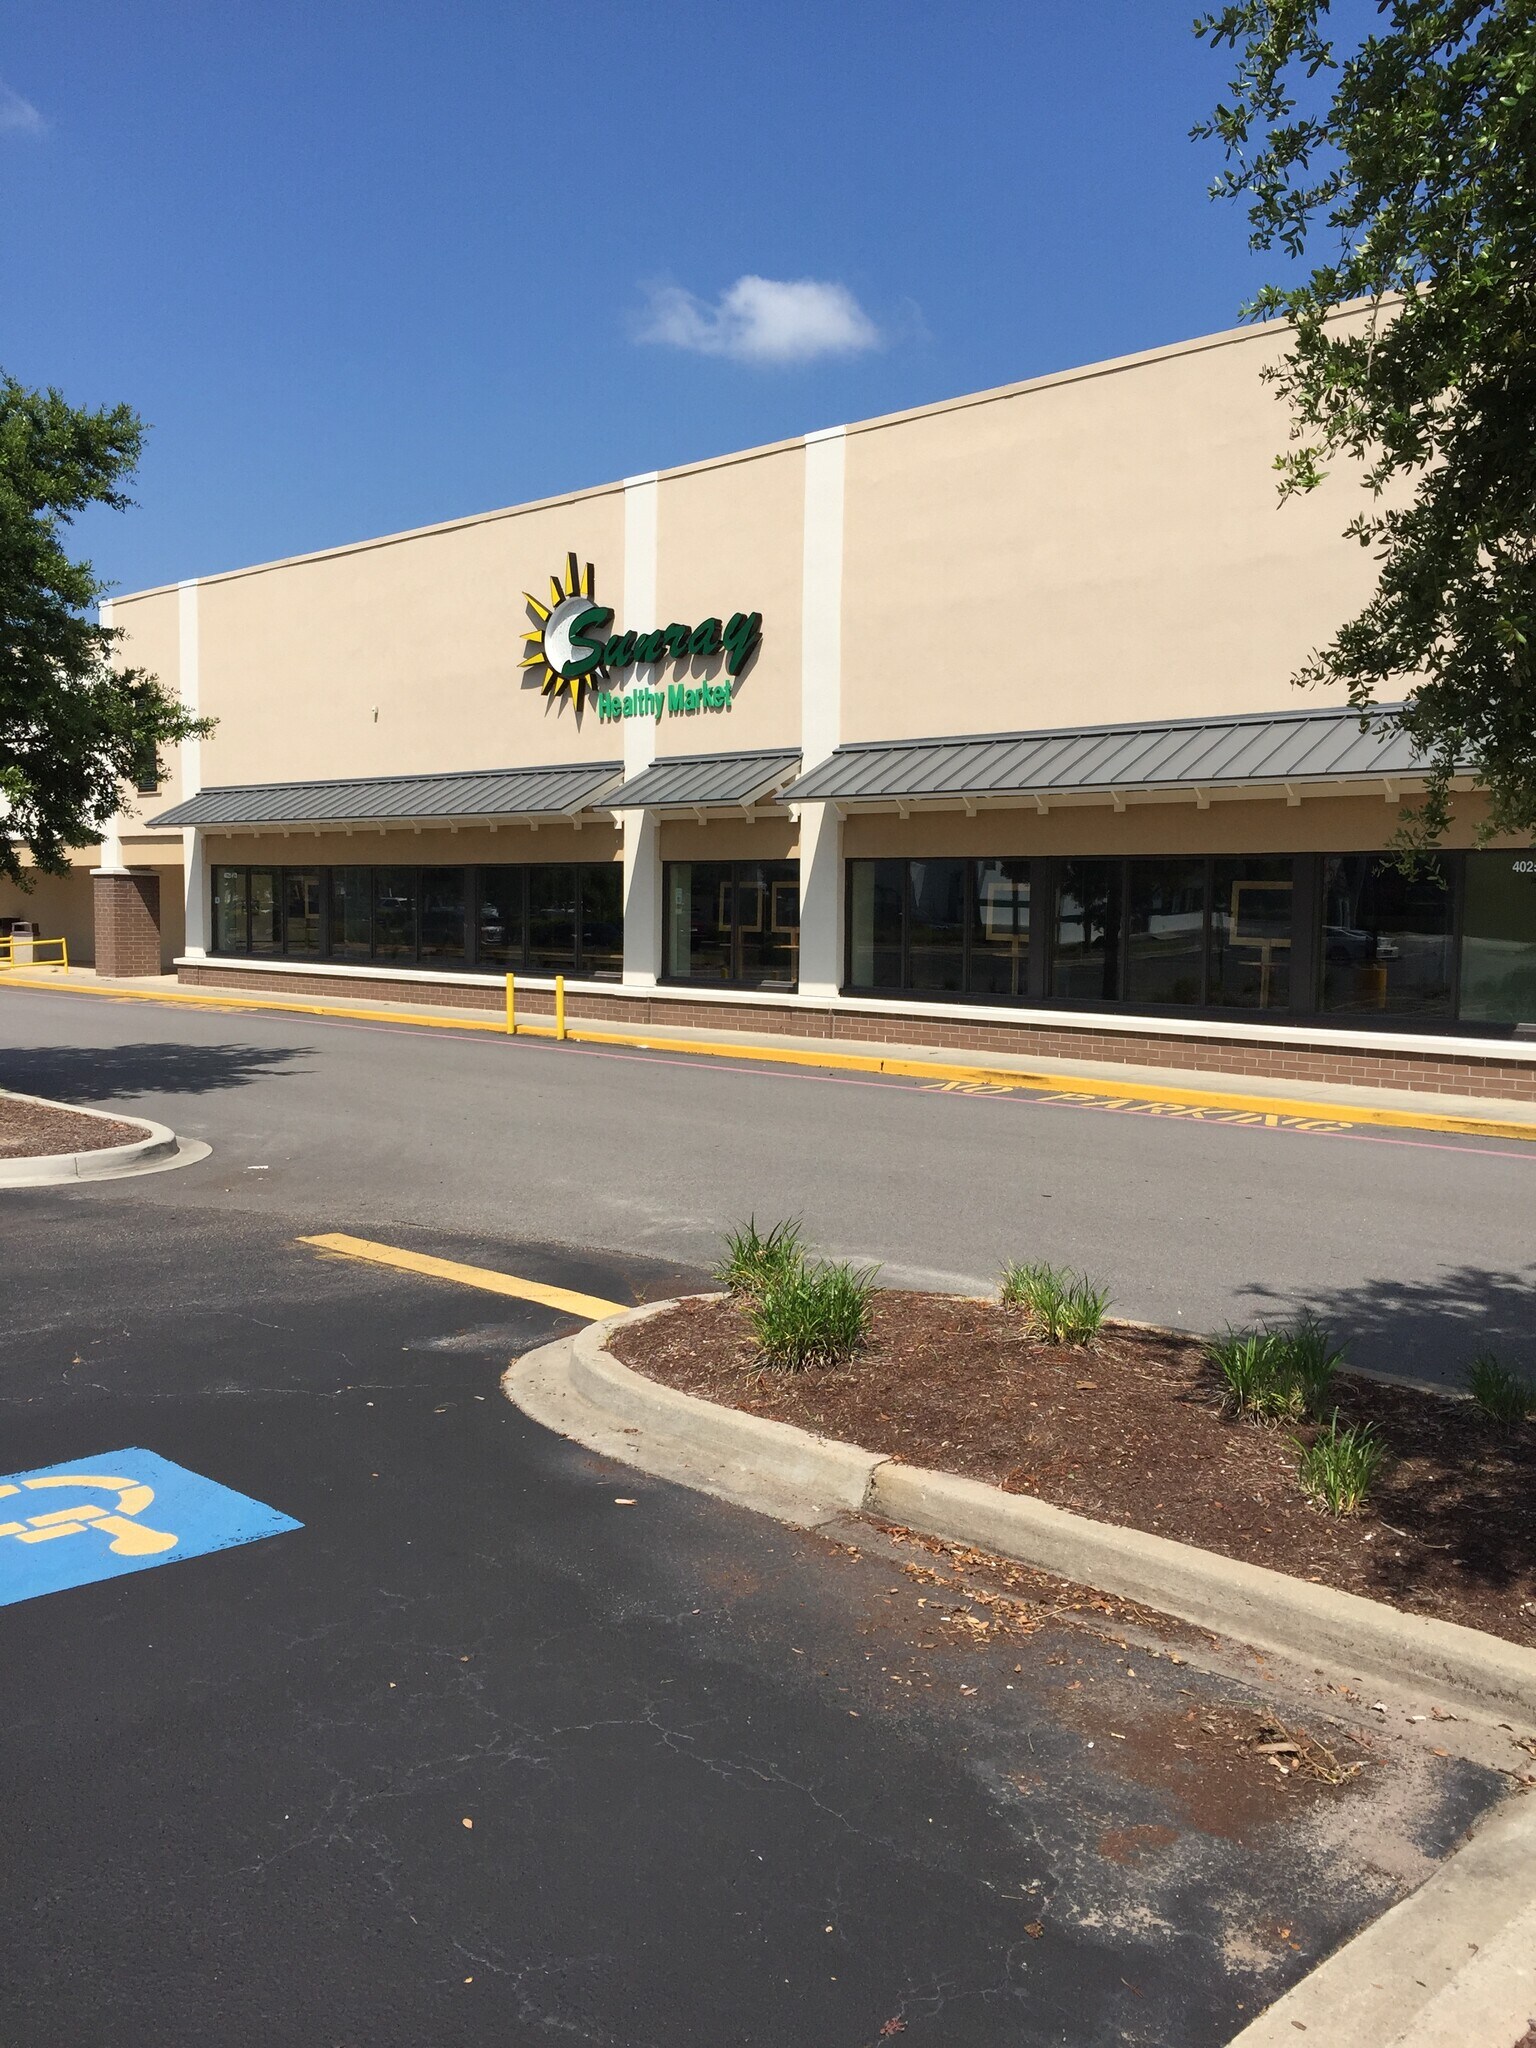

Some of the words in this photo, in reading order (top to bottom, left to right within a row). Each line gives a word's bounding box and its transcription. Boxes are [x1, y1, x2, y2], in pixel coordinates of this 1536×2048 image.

[561, 606, 762, 678] Sunray
[598, 686, 664, 719] Healthy
[668, 679, 732, 711] Market
[919, 1081, 1014, 1095] NO
[1036, 1092, 1354, 1132] PARKING
